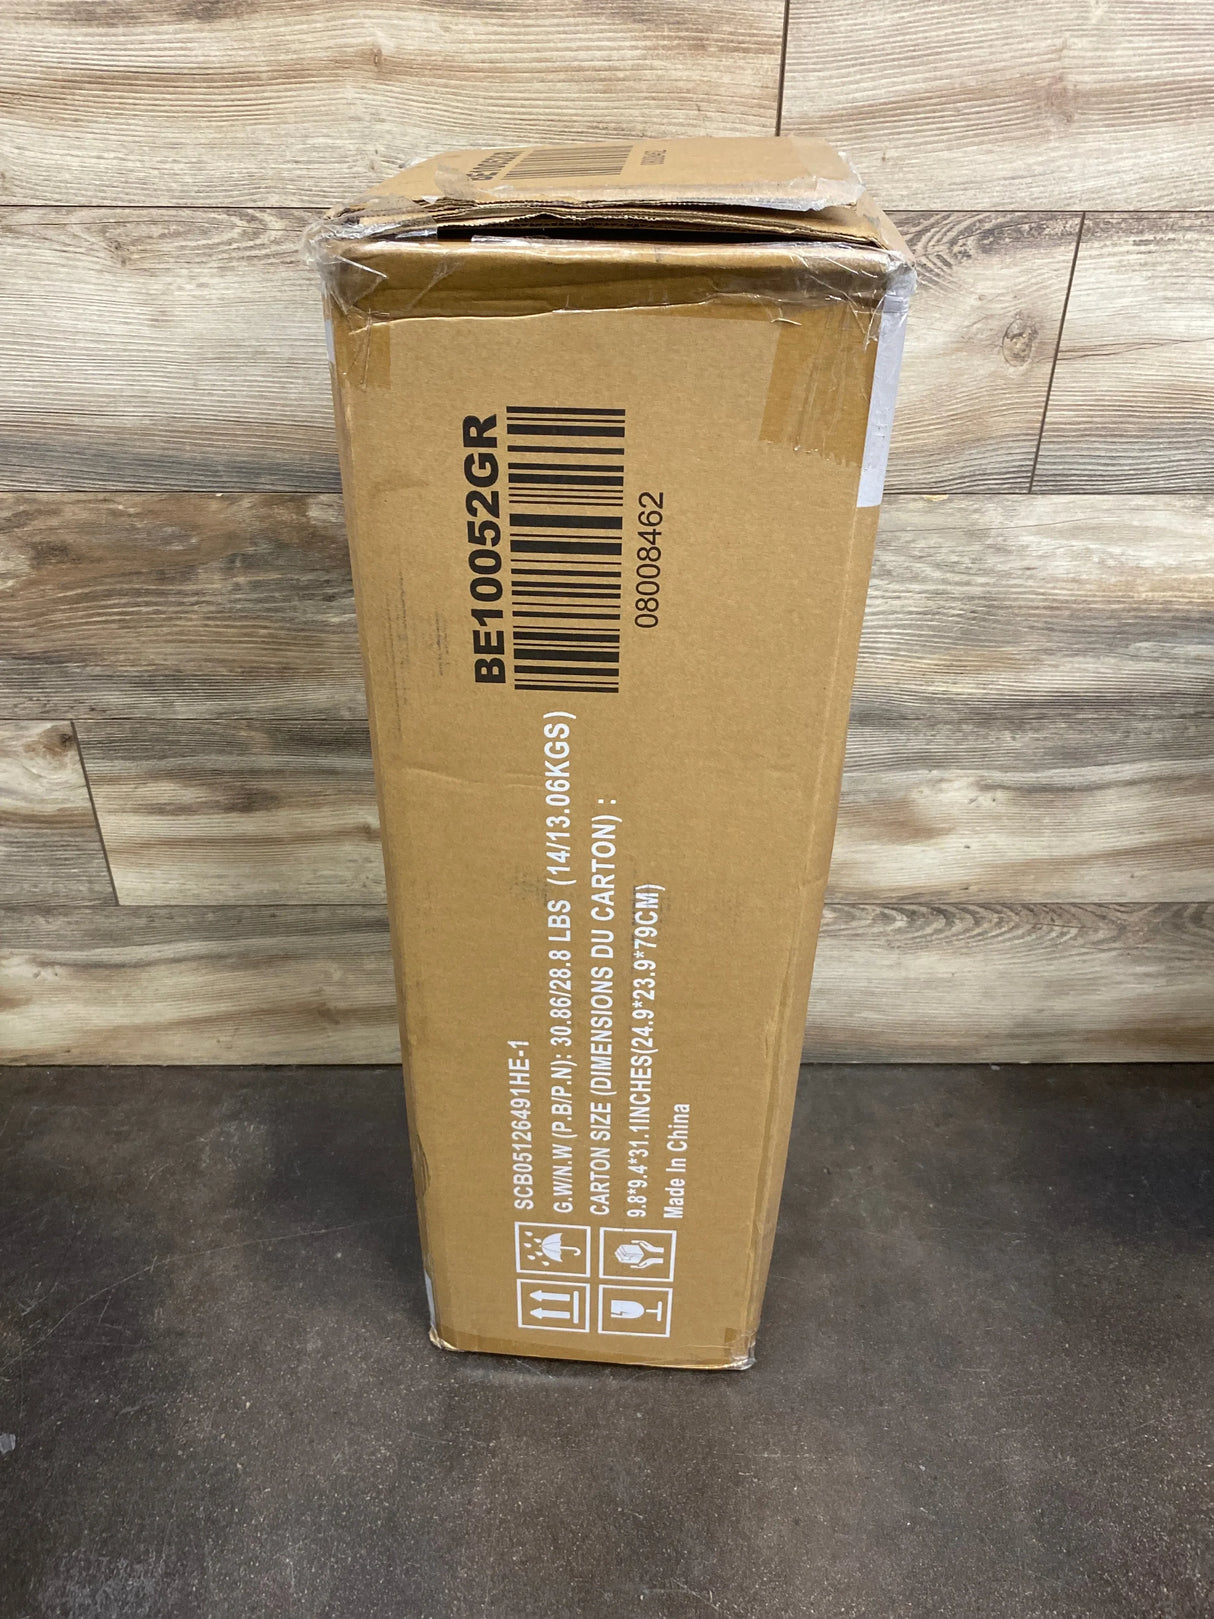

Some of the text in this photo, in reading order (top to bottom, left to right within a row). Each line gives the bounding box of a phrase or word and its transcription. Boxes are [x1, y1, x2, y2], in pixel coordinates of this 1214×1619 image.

[463, 414, 505, 683] BE10052GR
[635, 492, 663, 628] 08008462
[591, 815, 622, 921] CARTON)
[543, 712, 578, 1213] G.W/N.W (P.B/P.N): 30.86/28.8 LBS (14/13.06KGS)
[591, 930, 614, 958] DU
[590, 967, 617, 1095] (DIMENSIONS
[507, 1041, 534, 1210] SCB05126491HE-1
[590, 1102, 611, 1141] SIZE
[590, 1147, 610, 1215] CARTON
[664, 1104, 690, 1218] Made In China
